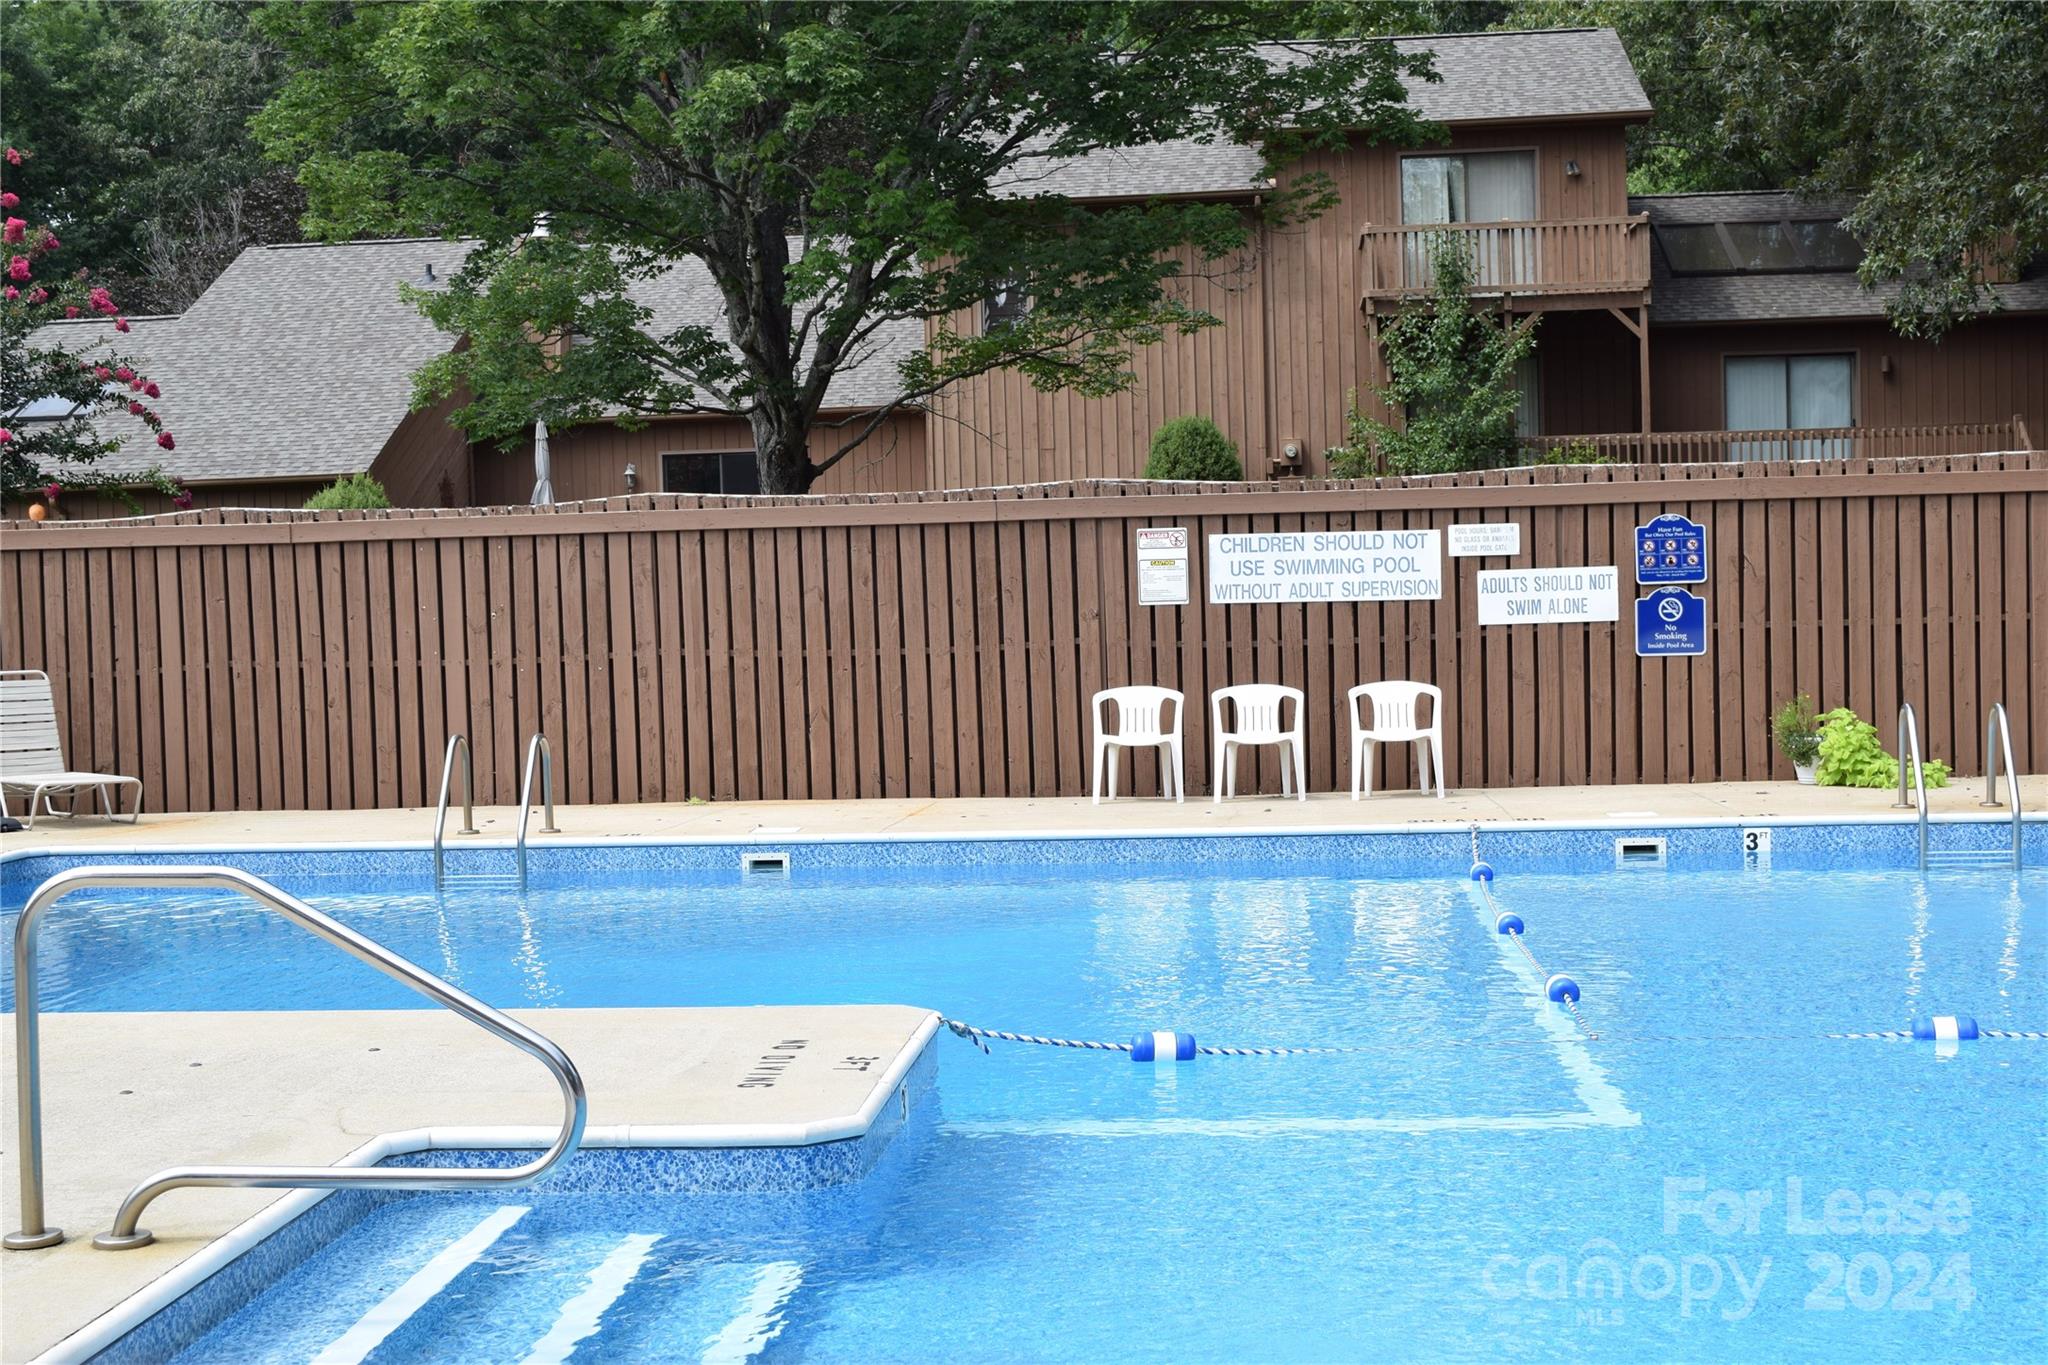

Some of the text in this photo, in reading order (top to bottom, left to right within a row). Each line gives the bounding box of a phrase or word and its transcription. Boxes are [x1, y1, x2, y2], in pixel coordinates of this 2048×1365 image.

[1220, 533, 1428, 554] CHILDREN SHOULD NOT
[1230, 556, 1421, 576] USE SWIMMING POOL
[1215, 579, 1439, 600] WITHOUT ADULT SUPERVISION
[1481, 573, 1614, 594] ADULTS SHOULD NOT
[1507, 597, 1588, 616] SWIM ALONE
[1654, 632, 1688, 641] Smoking
[1746, 831, 1769, 851] 3 FT
[737, 1039, 810, 1088] NO DIVING
